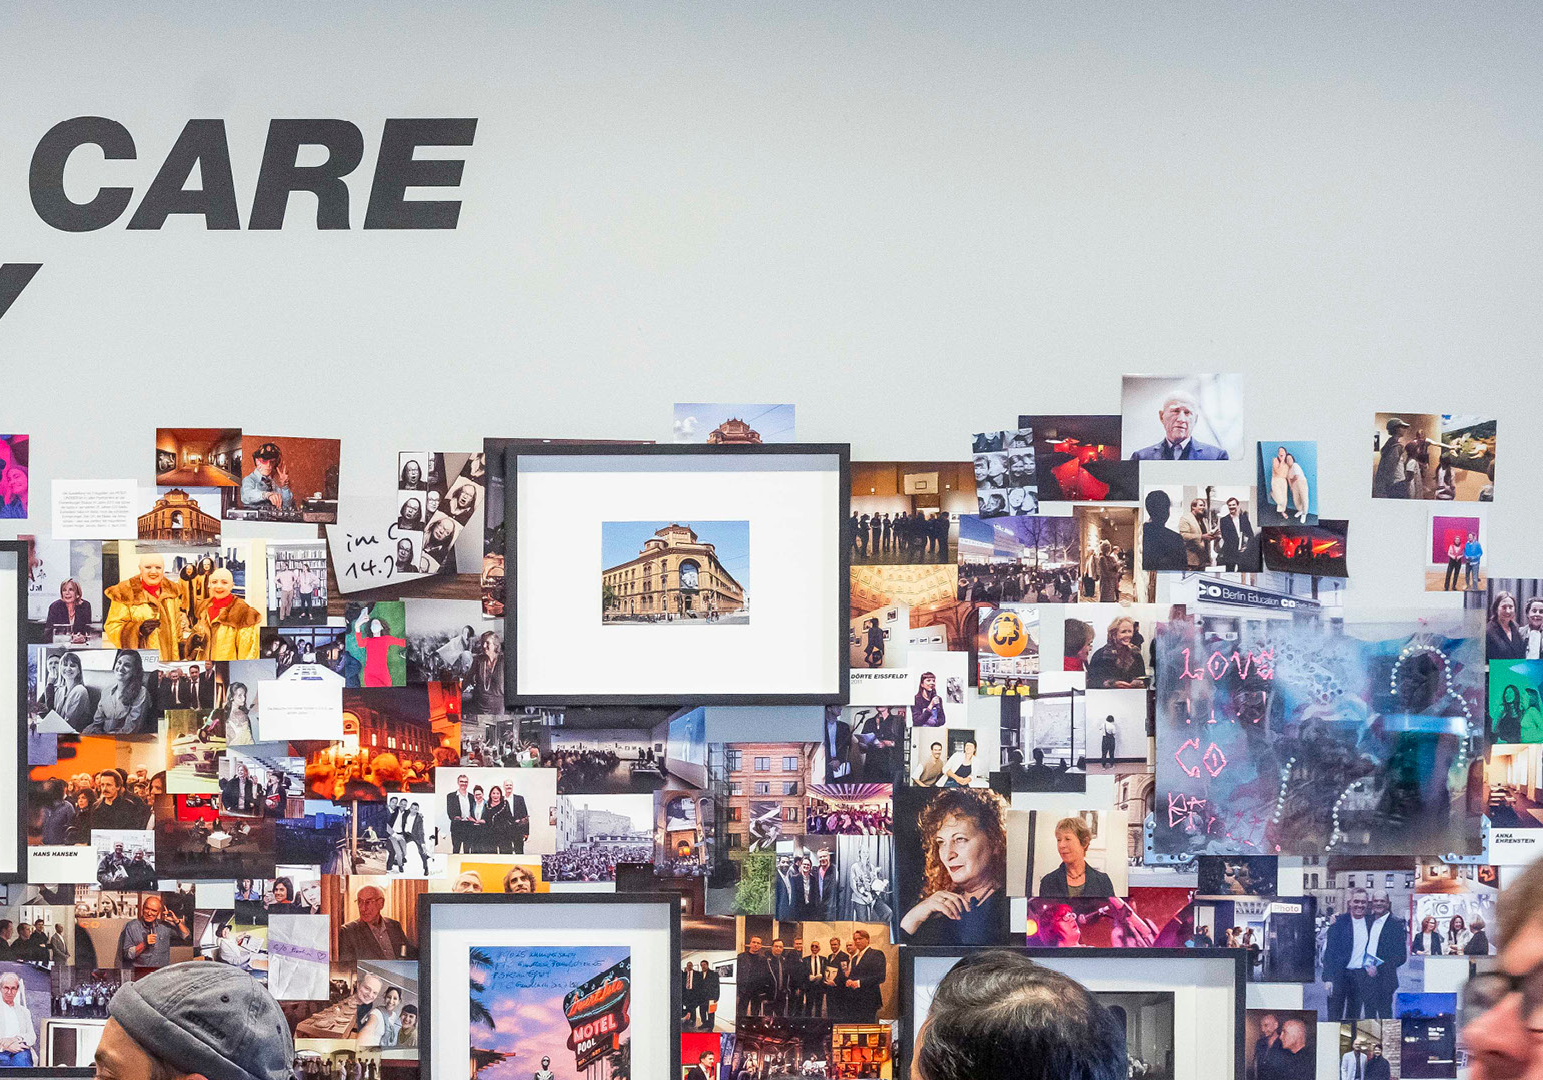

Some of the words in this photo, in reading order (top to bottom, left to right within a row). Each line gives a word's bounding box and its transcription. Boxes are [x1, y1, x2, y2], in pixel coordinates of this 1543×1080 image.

[28, 115, 479, 232] CARE
[1222, 587, 1246, 601] Berlin
[1247, 592, 1280, 606] Education
[1179, 647, 1274, 681] LOVE
[1274, 904, 1300, 912] Photo
[572, 1013, 617, 1043] MOTEL
[576, 1038, 597, 1055] POOL
